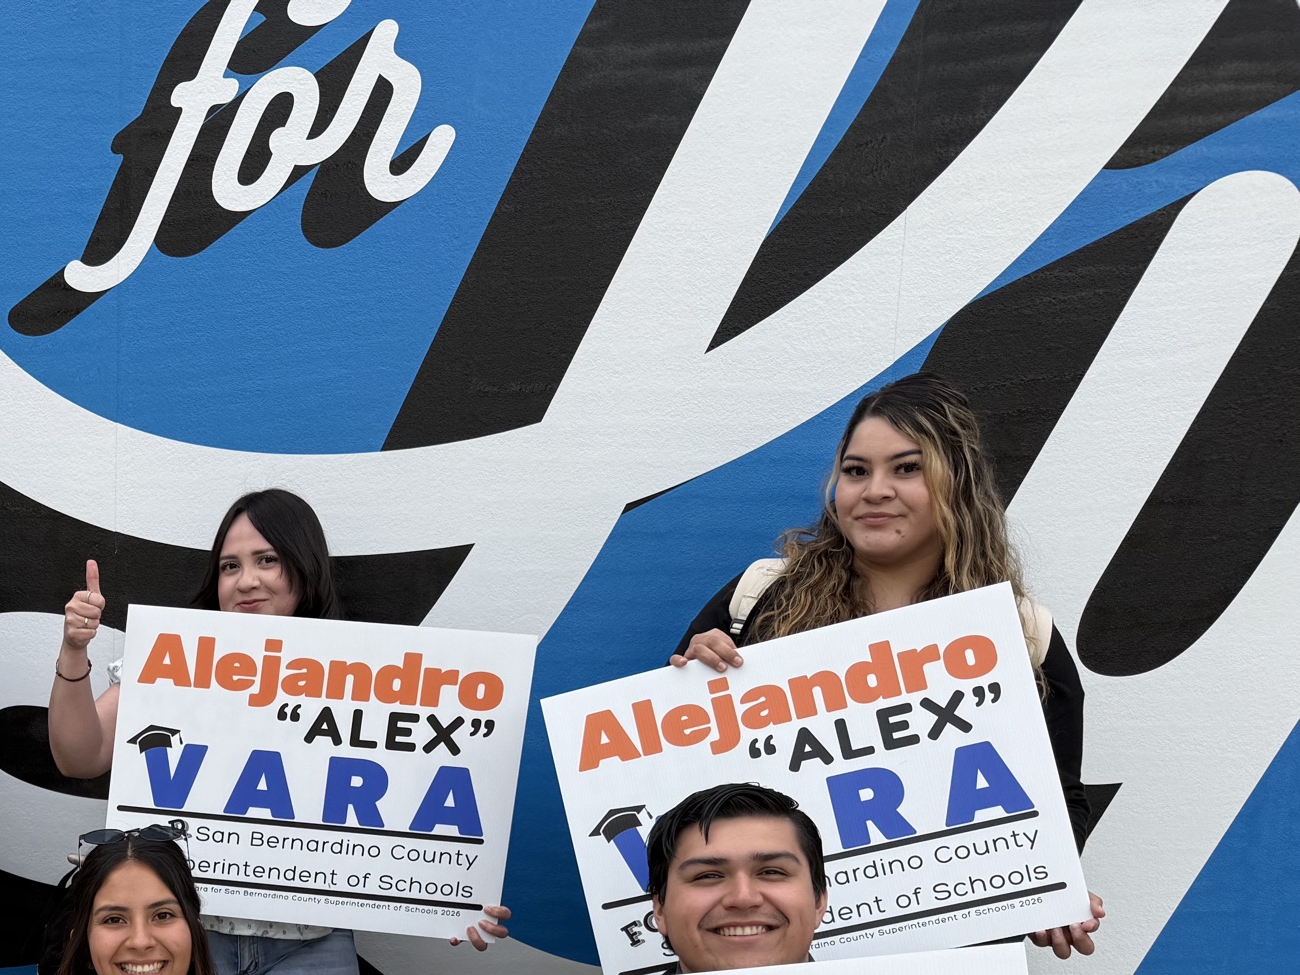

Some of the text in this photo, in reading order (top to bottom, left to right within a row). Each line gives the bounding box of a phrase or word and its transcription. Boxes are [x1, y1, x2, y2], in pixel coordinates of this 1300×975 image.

[63, 0, 456, 293] for
[137, 635, 503, 712] Alejandro
[578, 636, 998, 772] Alejandro
[748, 682, 1001, 773] “ALEX”
[277, 703, 495, 756] “ALEX”
[144, 744, 483, 837] VARA
[196, 826, 240, 845] San
[250, 831, 381, 858] Bernardino
[391, 844, 478, 872] County
[934, 829, 1038, 864] County
[243, 889, 289, 900] Bernardino
[291, 894, 322, 905] County
[324, 898, 390, 911] Superintendent
[404, 906, 438, 916] Schools
[440, 910, 460, 918] 2026
[347, 872, 372, 889] of
[378, 875, 473, 899] Schools
[895, 864, 1049, 909] of Schools
[838, 932, 874, 944] County
[877, 914, 959, 937] Superintendent
[961, 910, 971, 919] of
[974, 903, 1016, 917] Schools
[1019, 896, 1043, 908] 2026
